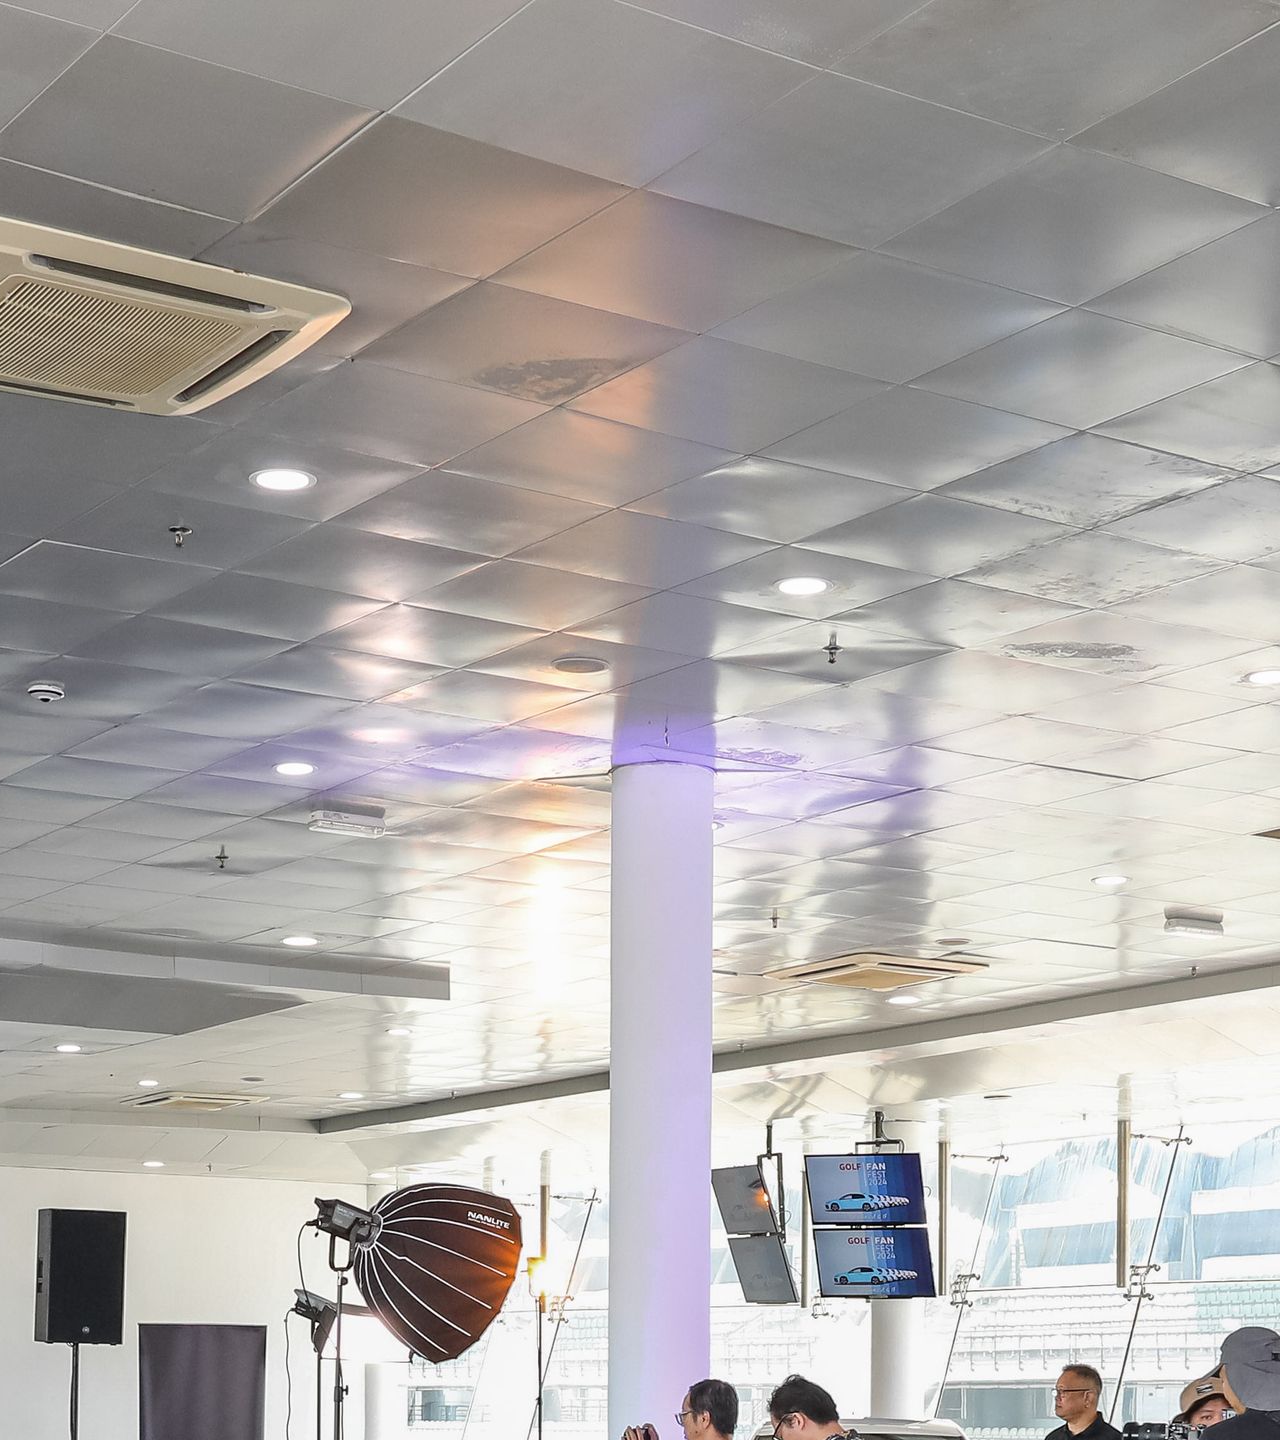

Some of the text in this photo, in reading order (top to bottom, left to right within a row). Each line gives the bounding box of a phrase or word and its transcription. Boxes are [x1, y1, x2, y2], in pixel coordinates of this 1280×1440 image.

[839, 1162, 886, 1171] GOLF FAN
[467, 1211, 510, 1229] NANLITE
[848, 1236, 894, 1245] GOLF FAN
